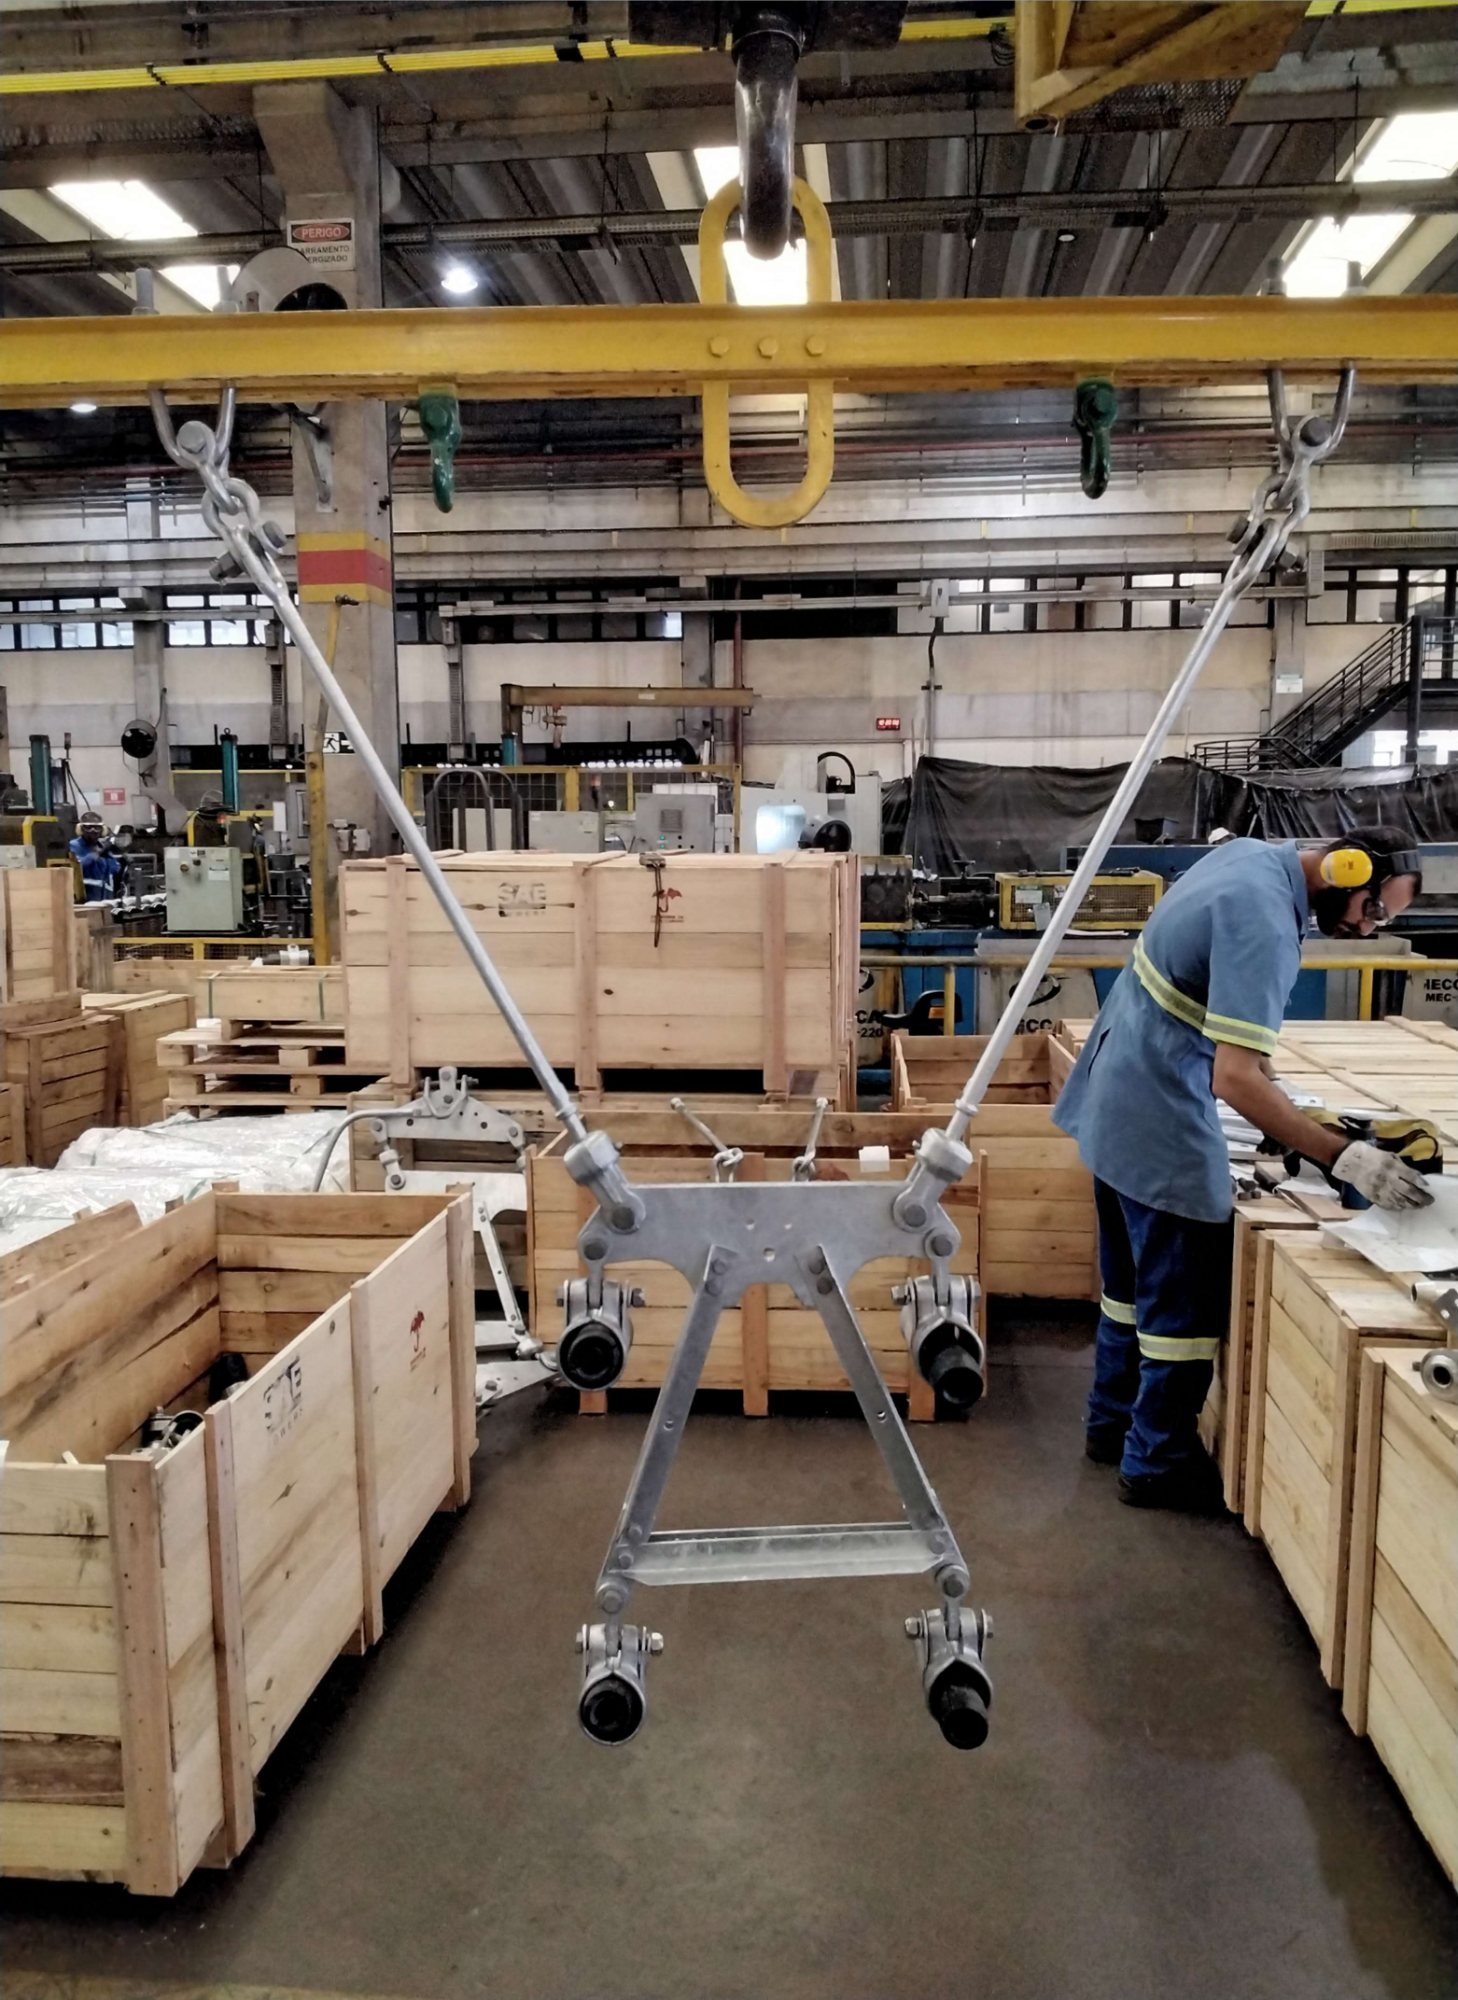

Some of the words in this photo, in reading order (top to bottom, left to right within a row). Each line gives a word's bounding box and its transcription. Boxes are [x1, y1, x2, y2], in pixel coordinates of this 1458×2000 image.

[302, 227, 342, 239] PERIGO
[300, 245, 350, 255] ARRAMENTO
[308, 255, 348, 264] ERGIZADO
